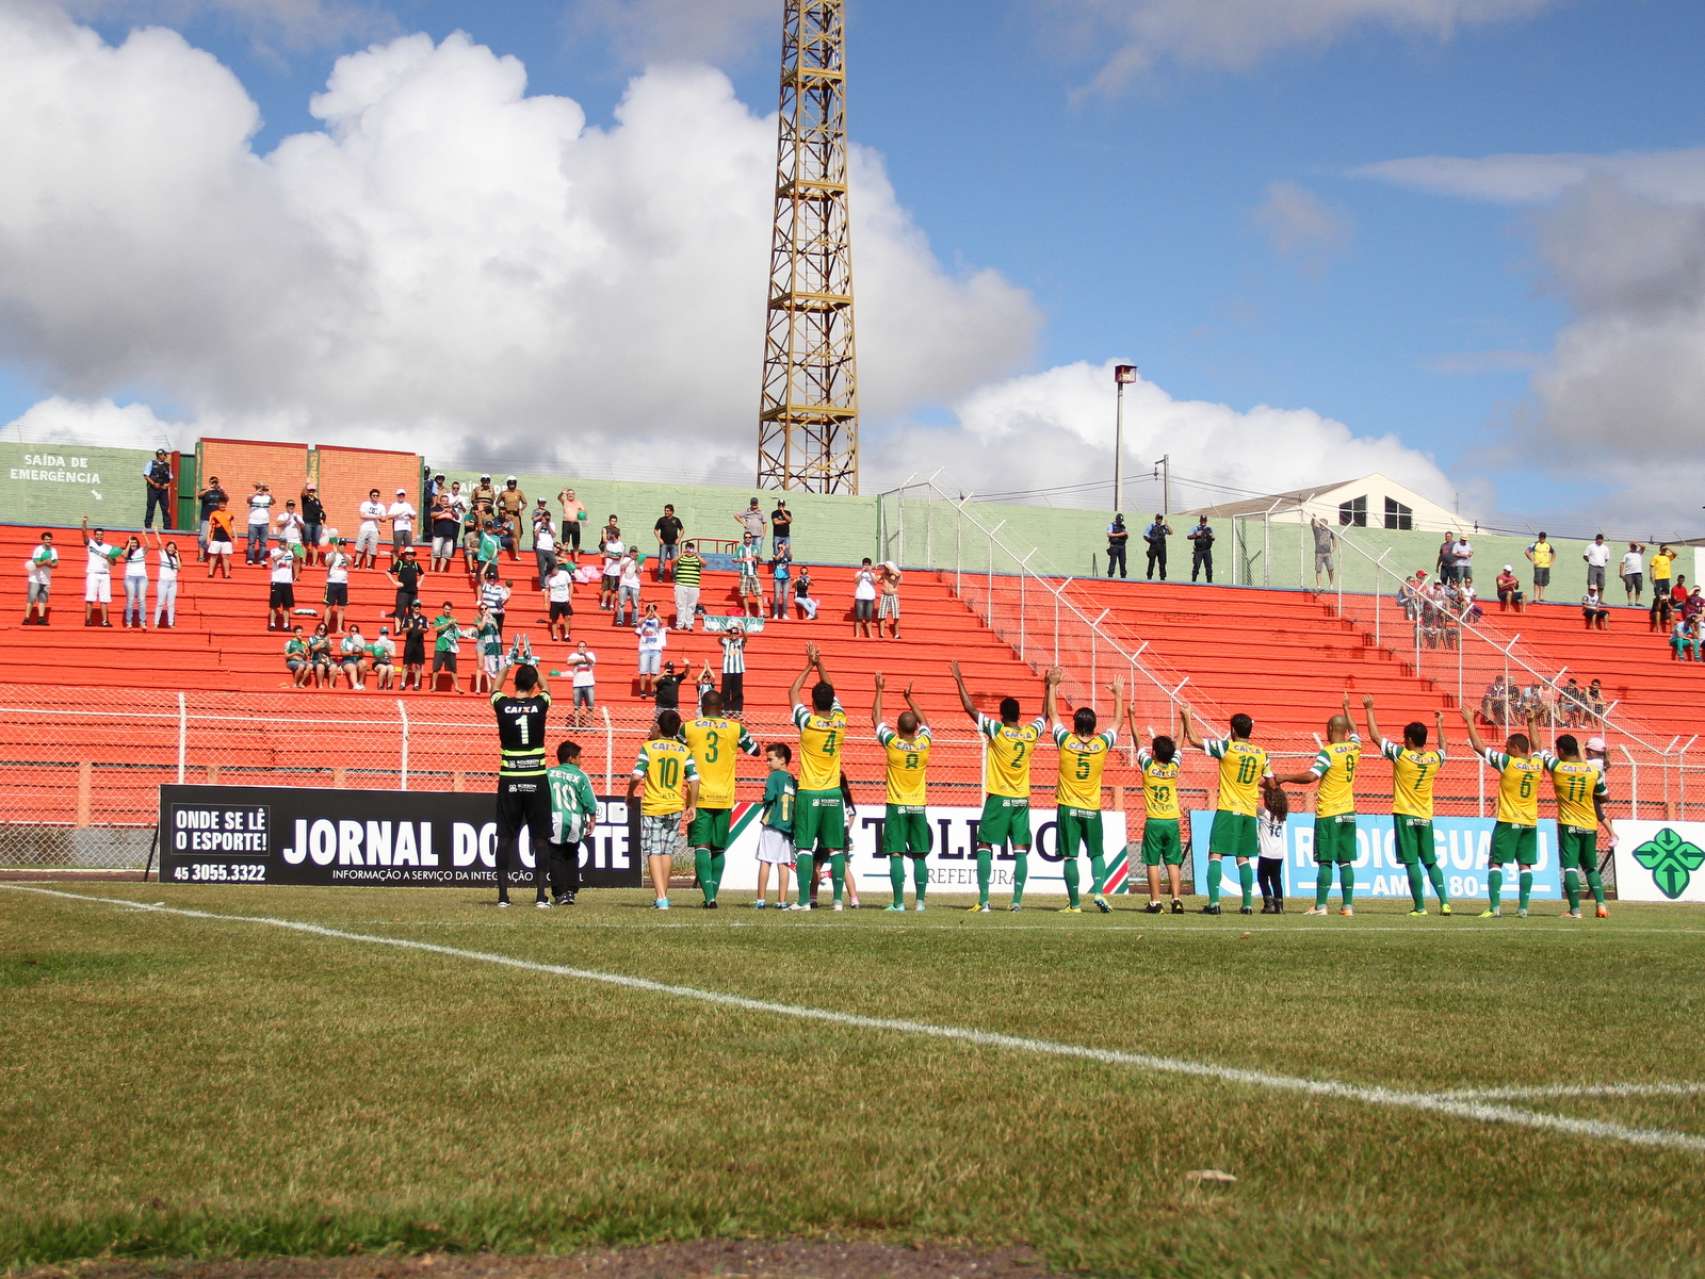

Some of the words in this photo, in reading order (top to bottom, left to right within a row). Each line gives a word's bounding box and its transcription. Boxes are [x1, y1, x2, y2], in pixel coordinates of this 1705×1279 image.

[24, 454, 66, 467] SAÍDA
[71, 457, 88, 468] DE
[10, 468, 101, 484] EMERGÊNCIA
[504, 705, 538, 713] CAIXA
[515, 714, 529, 745] 1
[705, 731, 718, 763] 3
[822, 731, 837, 756] 4
[1010, 741, 1025, 768] 2
[657, 757, 679, 789] 10
[1075, 752, 1090, 780] 5
[1236, 755, 1257, 784] 10
[1346, 754, 1354, 783] 9
[1414, 764, 1427, 789] 7
[552, 782, 578, 810] 10
[1520, 772, 1532, 798] 6
[1568, 776, 1586, 801] 11
[176, 811, 219, 829] ONDE
[224, 812, 243, 830] SE
[248, 808, 265, 830] LÊ
[782, 794, 795, 822] 1
[176, 831, 187, 850] O
[193, 832, 267, 851] ESPORTE!
[283, 819, 438, 866] JORNAL
[453, 822, 499, 867] DO
[519, 824, 630, 870] OTE
[862, 818, 1066, 863] TLO
[1295, 827, 1405, 869] RIO
[174, 867, 189, 880] 45
[192, 864, 266, 881] 3055.3322
[333, 869, 401, 881] INFORMAÇÃO
[403, 871, 411, 880] A
[412, 871, 453, 881] SERVIÇO
[456, 871, 469, 881] DA
[471, 870, 534, 883] INTEGÇÃO
[927, 868, 1016, 885] REFEIUR
[1371, 874, 1412, 896] AM
[1423, 875, 1479, 897] 180
